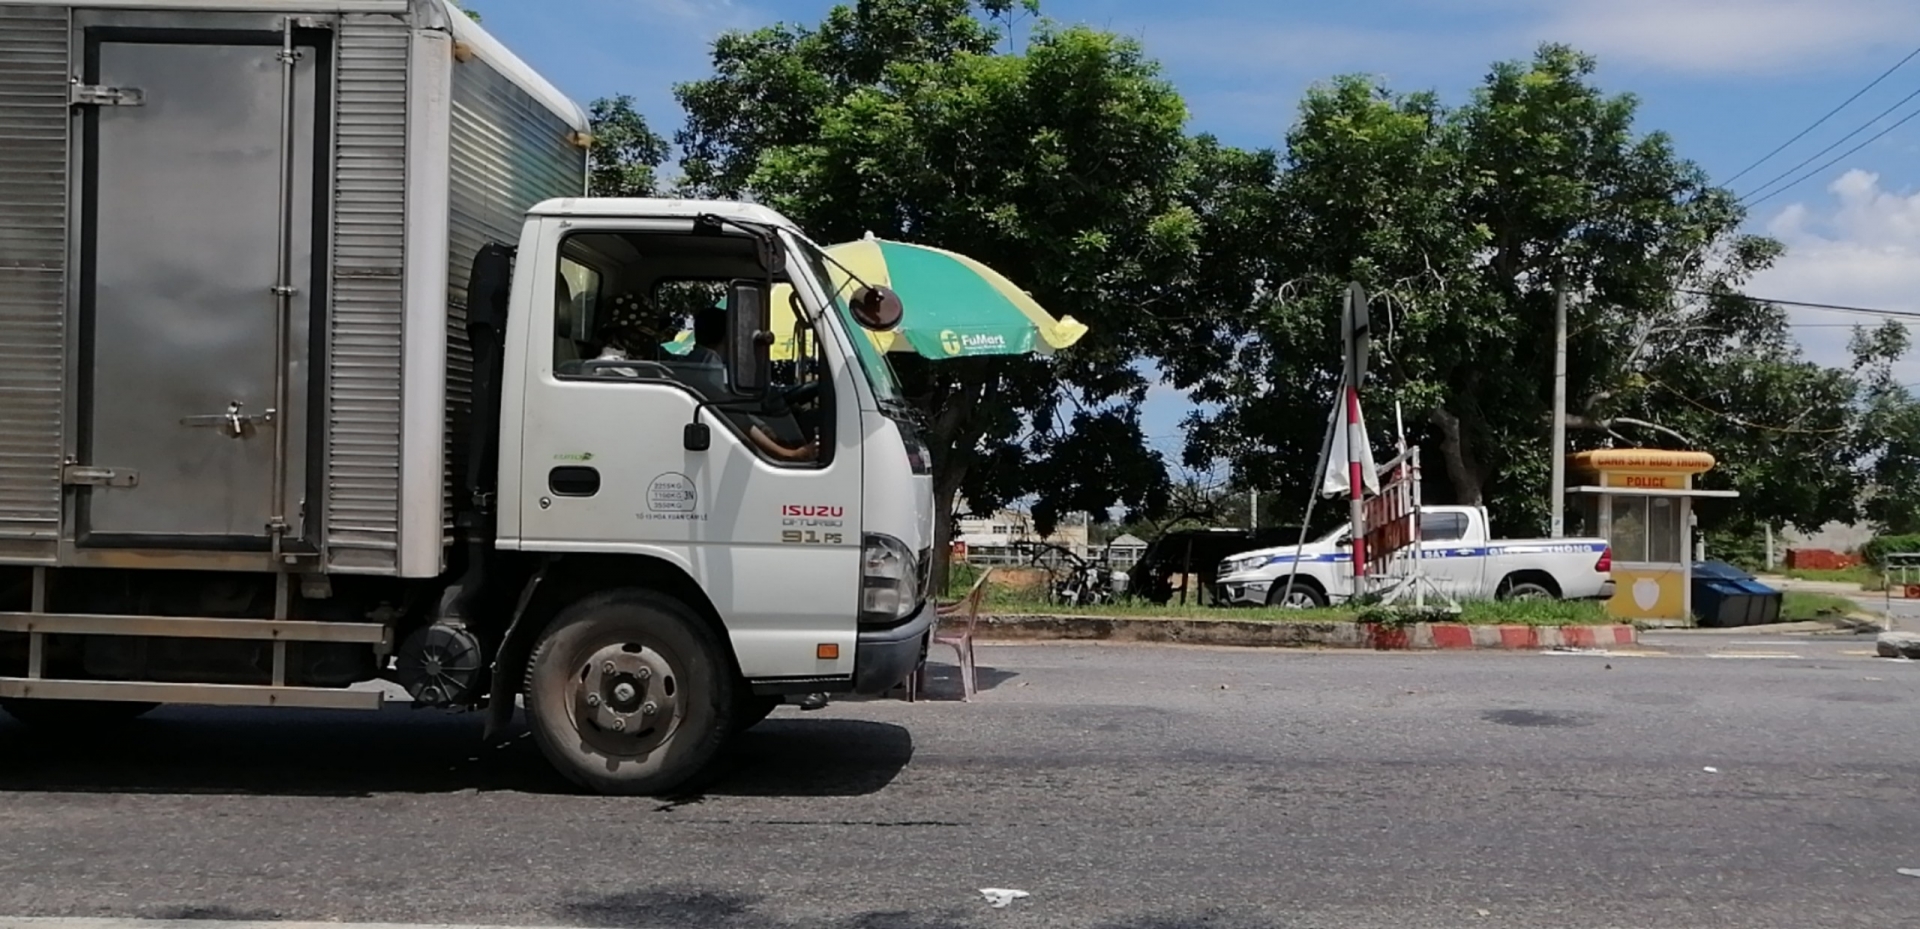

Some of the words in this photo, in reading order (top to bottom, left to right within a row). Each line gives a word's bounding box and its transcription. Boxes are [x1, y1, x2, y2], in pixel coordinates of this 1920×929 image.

[961, 334, 1005, 345] FuMart
[1626, 476, 1666, 487] POLICE
[782, 505, 843, 517] ISUZU
[782, 530, 820, 543] 91
[824, 533, 842, 543] PS
